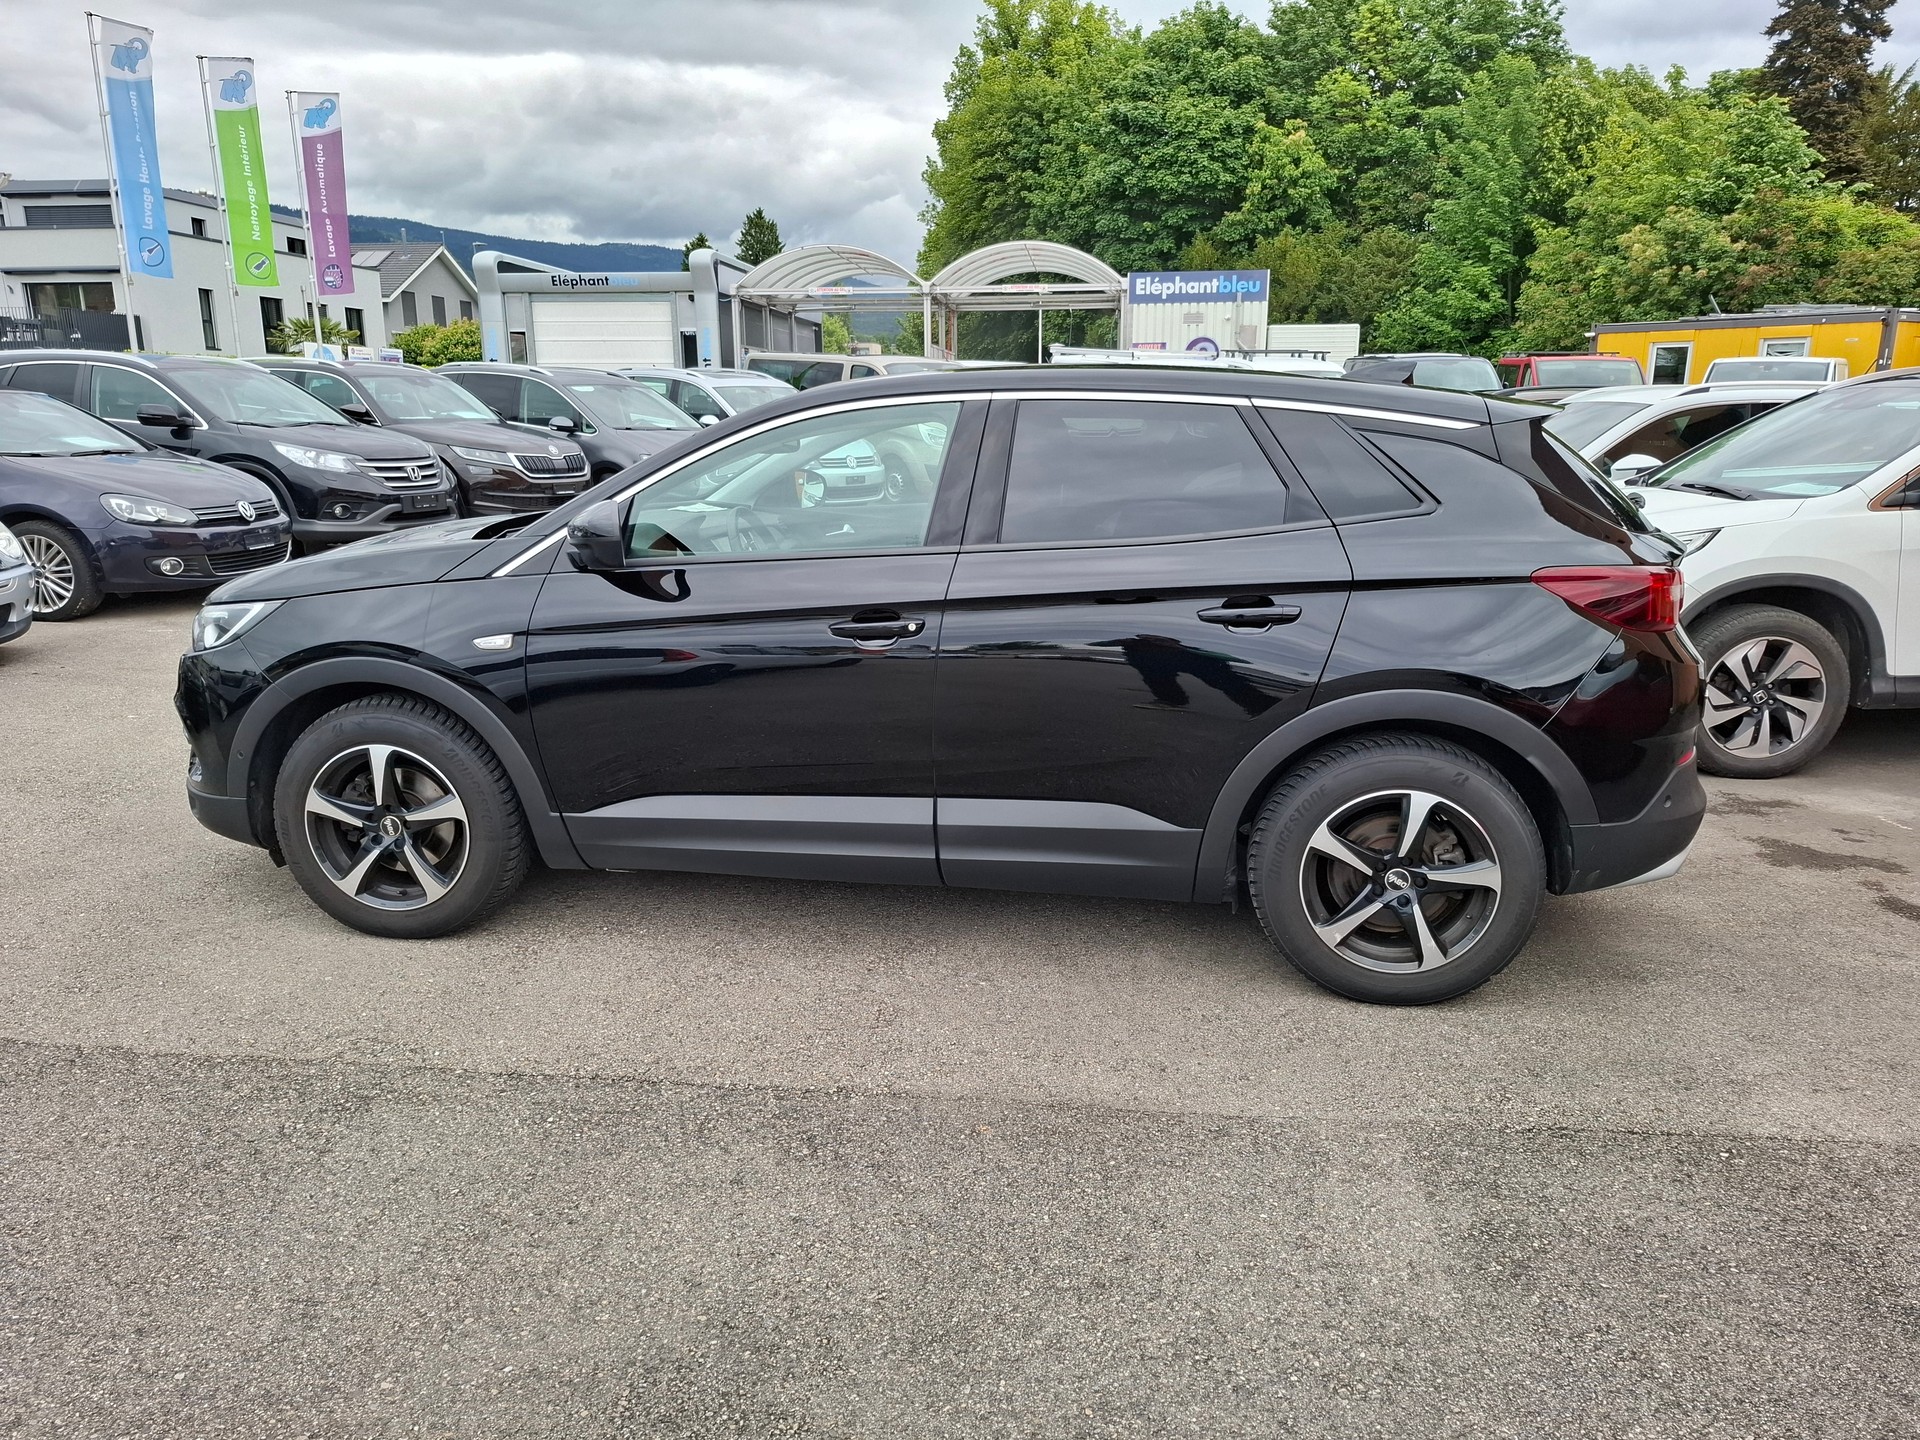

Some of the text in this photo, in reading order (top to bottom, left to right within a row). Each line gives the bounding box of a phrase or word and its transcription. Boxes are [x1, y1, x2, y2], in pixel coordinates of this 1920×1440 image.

[142, 187, 154, 230] Lavage
[238, 124, 261, 241] Nettoyage Intérieur
[315, 143, 336, 258] Lavage Automatique
[1135, 275, 1261, 299] Eléphantbleu
